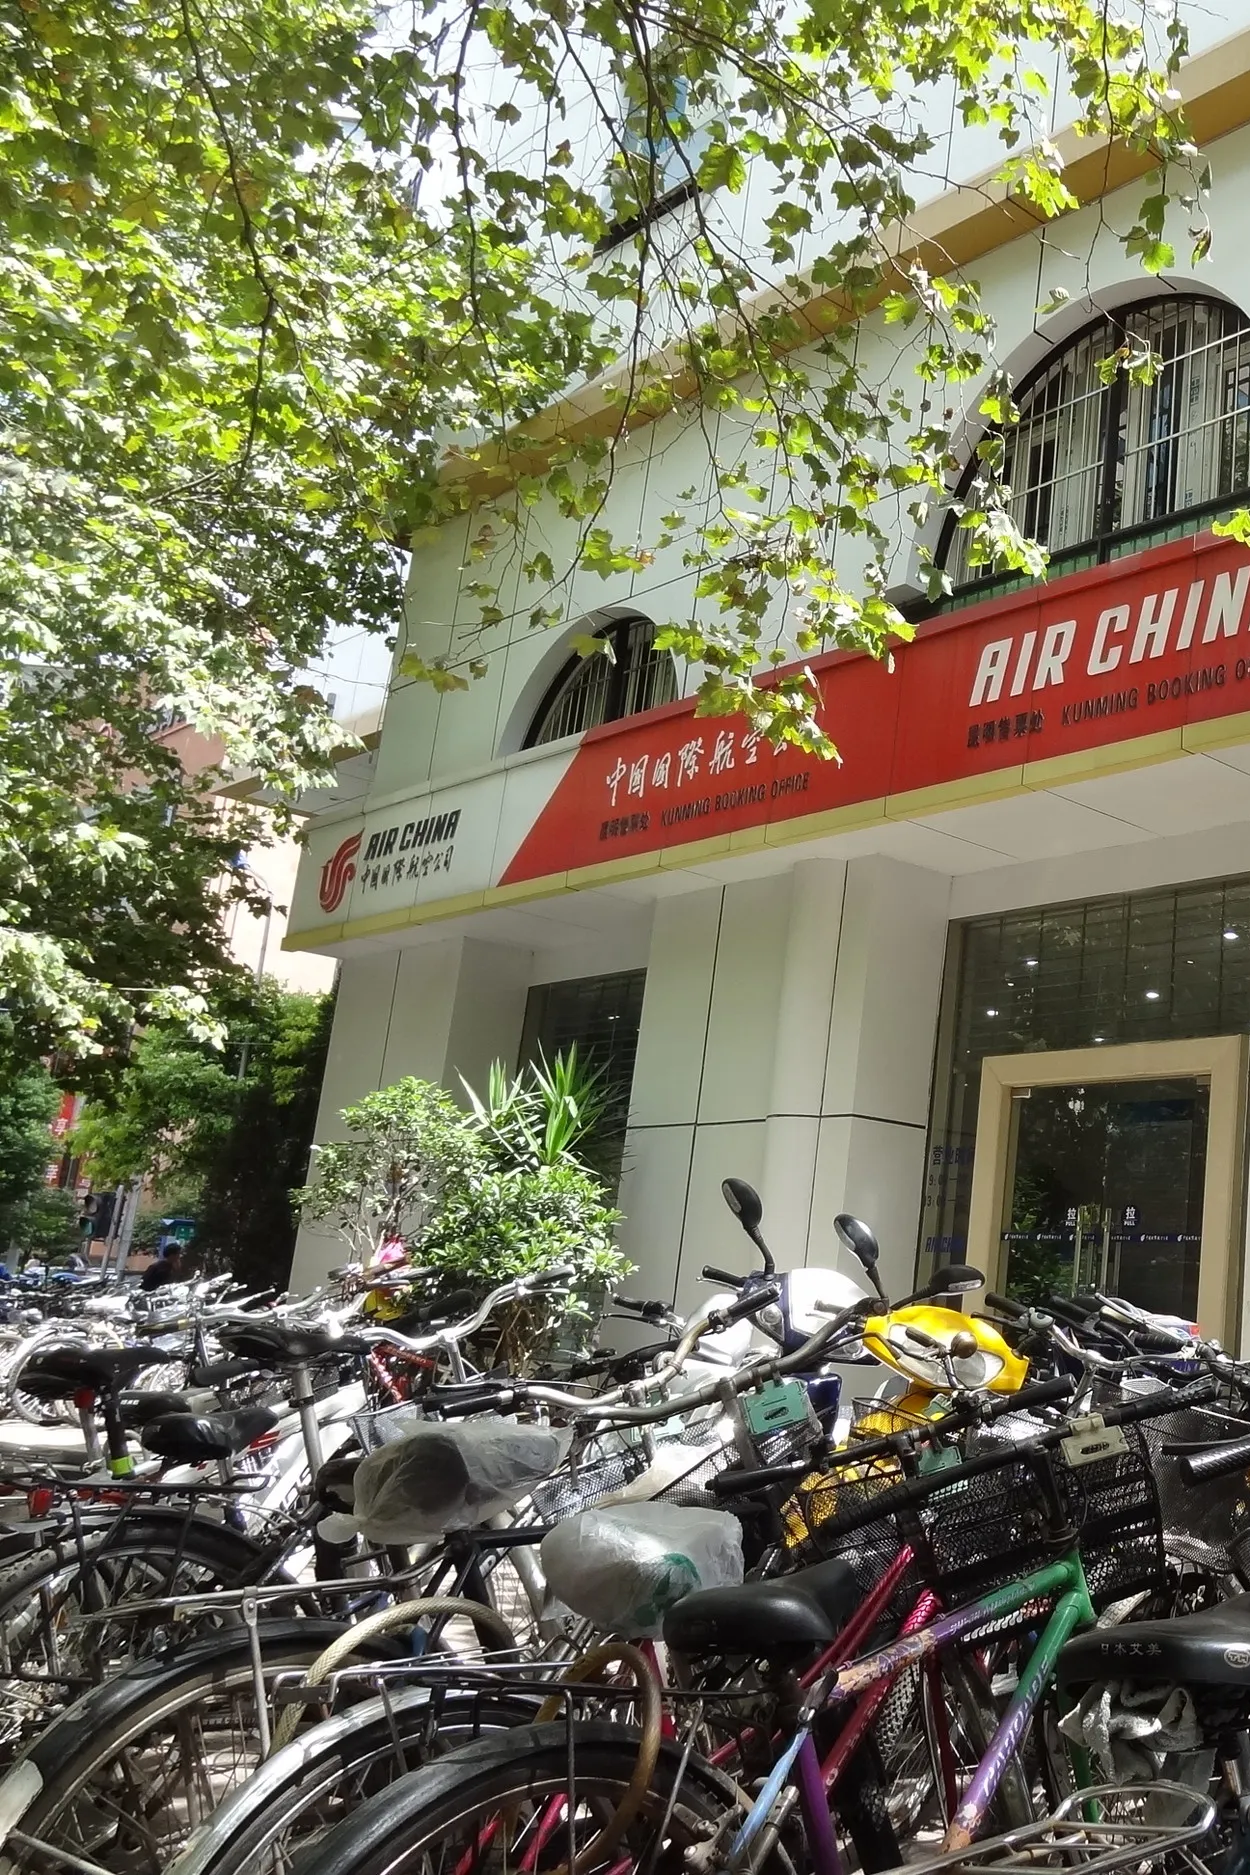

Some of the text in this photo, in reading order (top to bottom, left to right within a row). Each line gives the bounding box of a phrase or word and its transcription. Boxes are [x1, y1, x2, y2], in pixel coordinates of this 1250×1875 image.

[968, 619, 1078, 707] AIR
[1062, 687, 1138, 726] KUNMING
[1147, 663, 1226, 706] BOOKING
[660, 798, 710, 827] KUNMING
[714, 783, 766, 813] BOOKING
[770, 771, 810, 798] OFFICE
[363, 809, 462, 861] AIR CHINA
[1126, 1206, 1136, 1219] 拉
